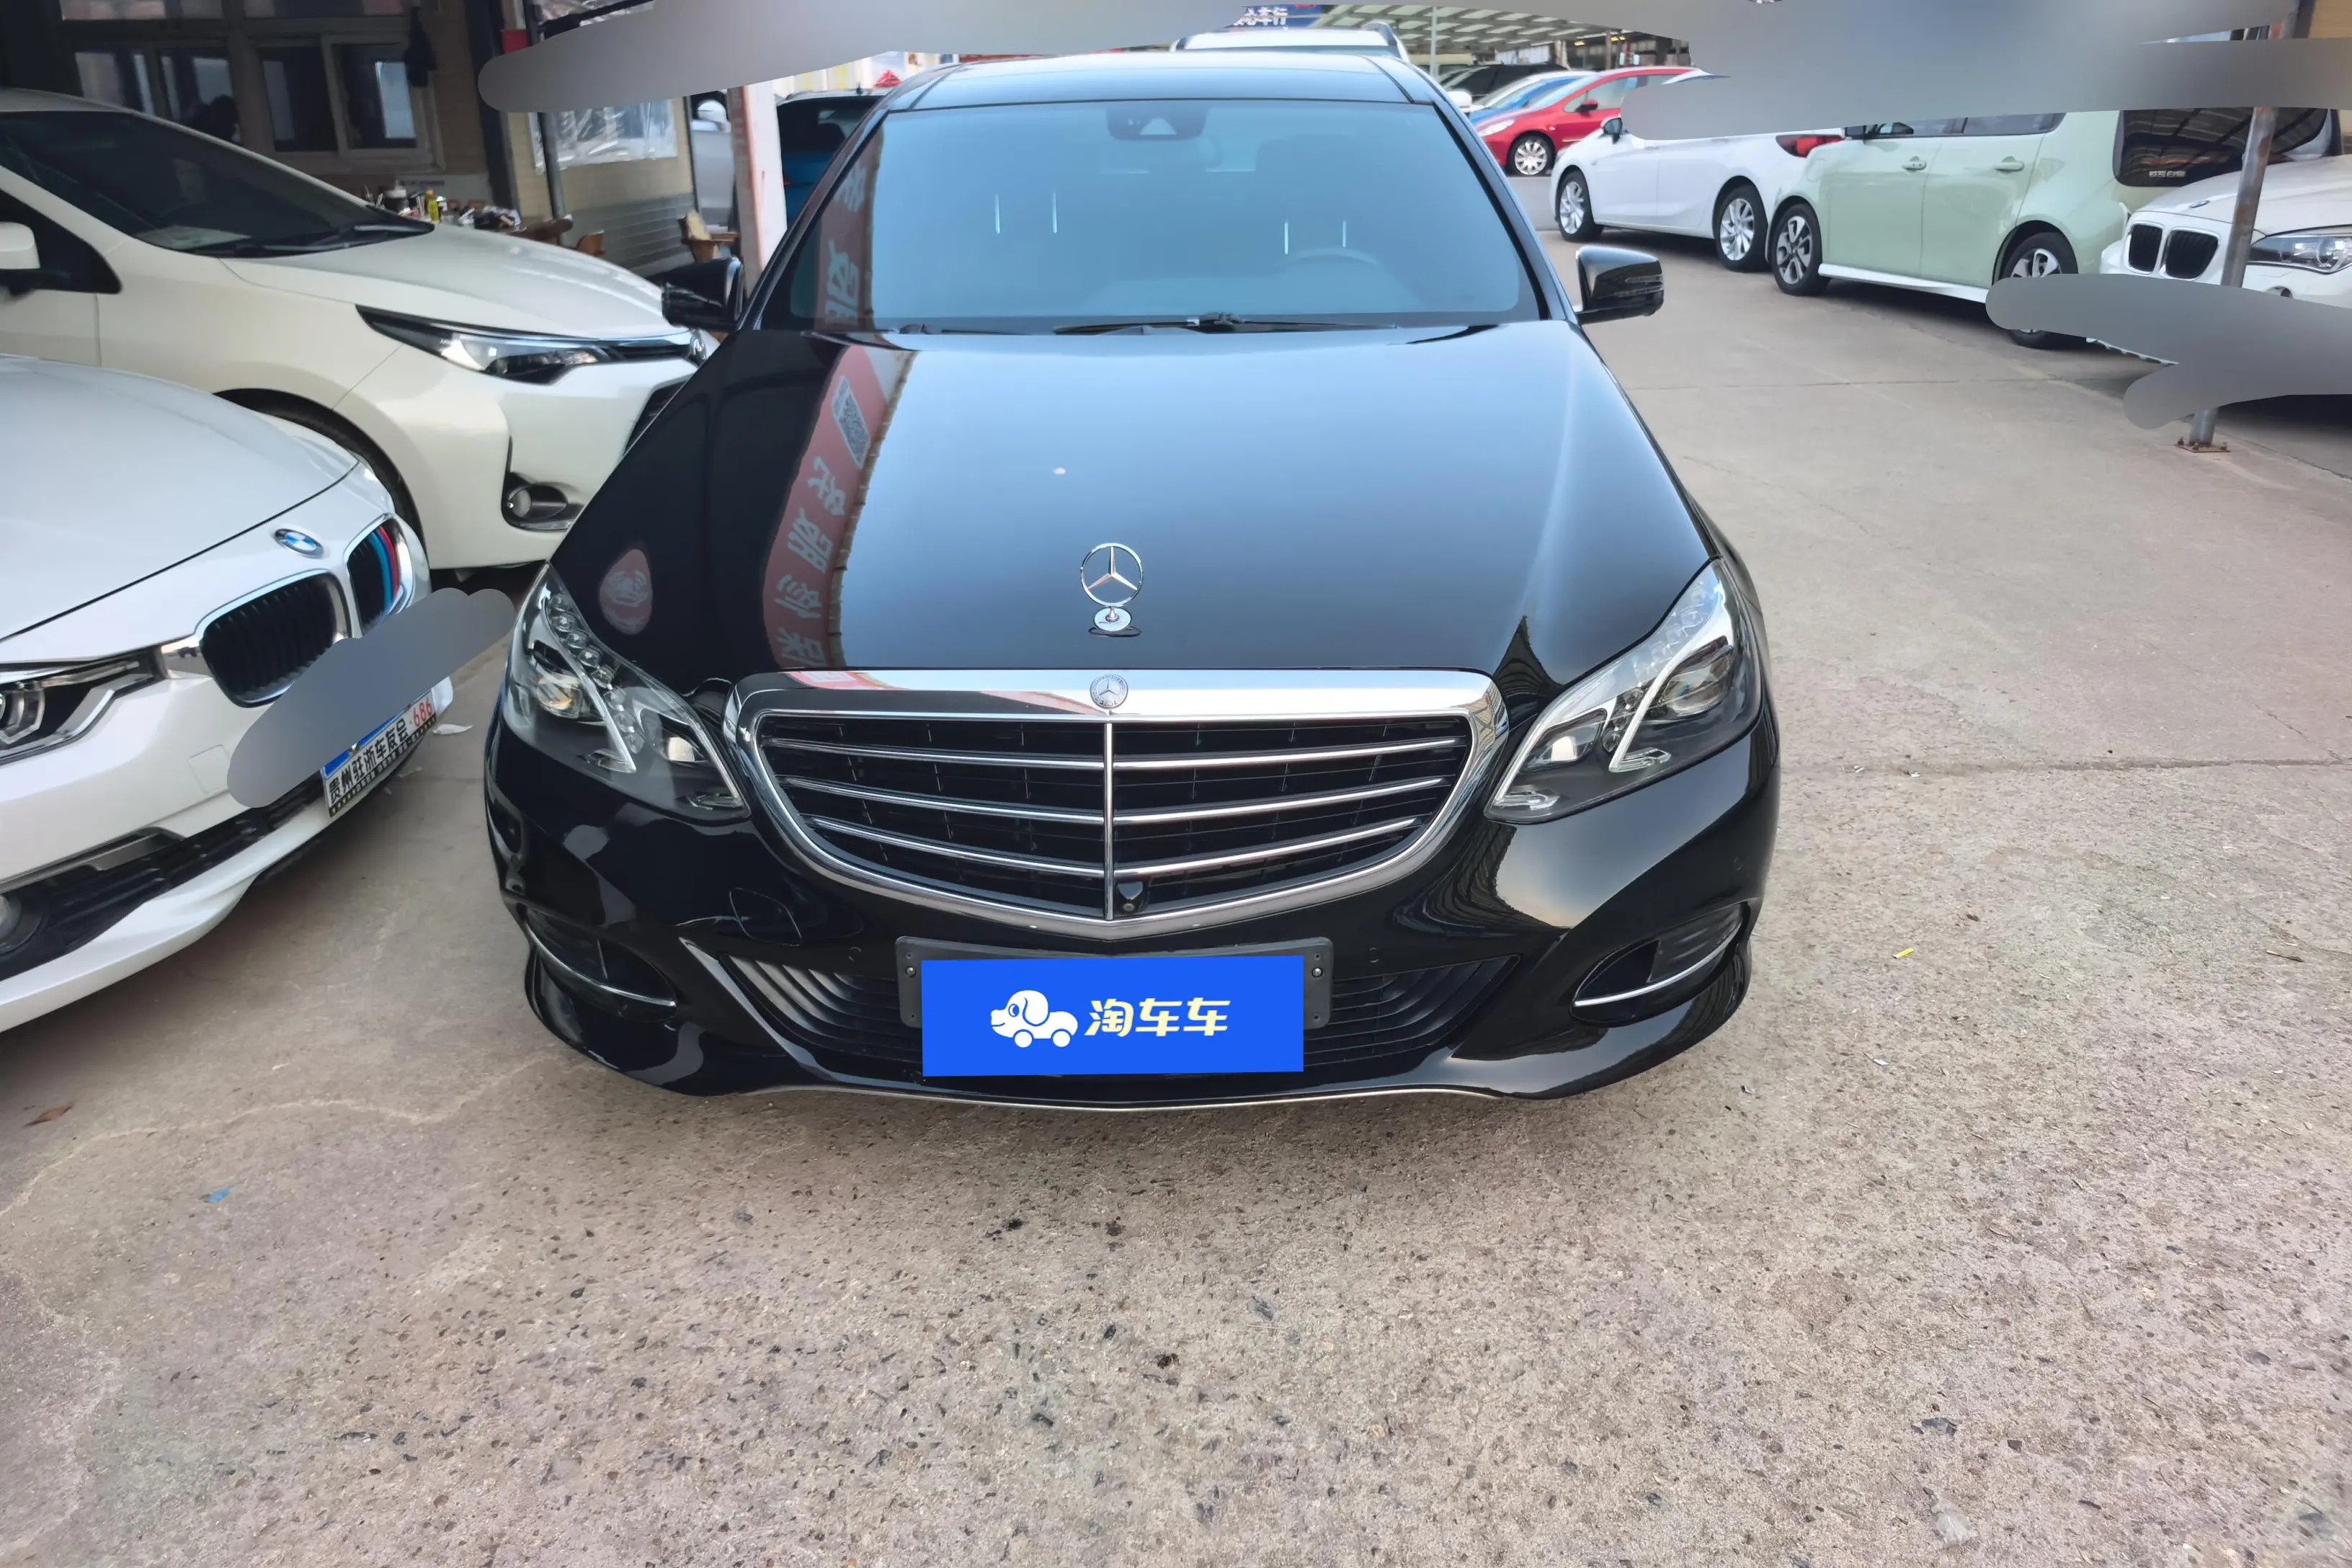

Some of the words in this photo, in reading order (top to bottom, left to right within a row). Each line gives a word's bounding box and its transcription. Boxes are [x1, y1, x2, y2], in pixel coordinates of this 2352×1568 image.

[329, 718, 408, 803] 贵州驻浙车友会
